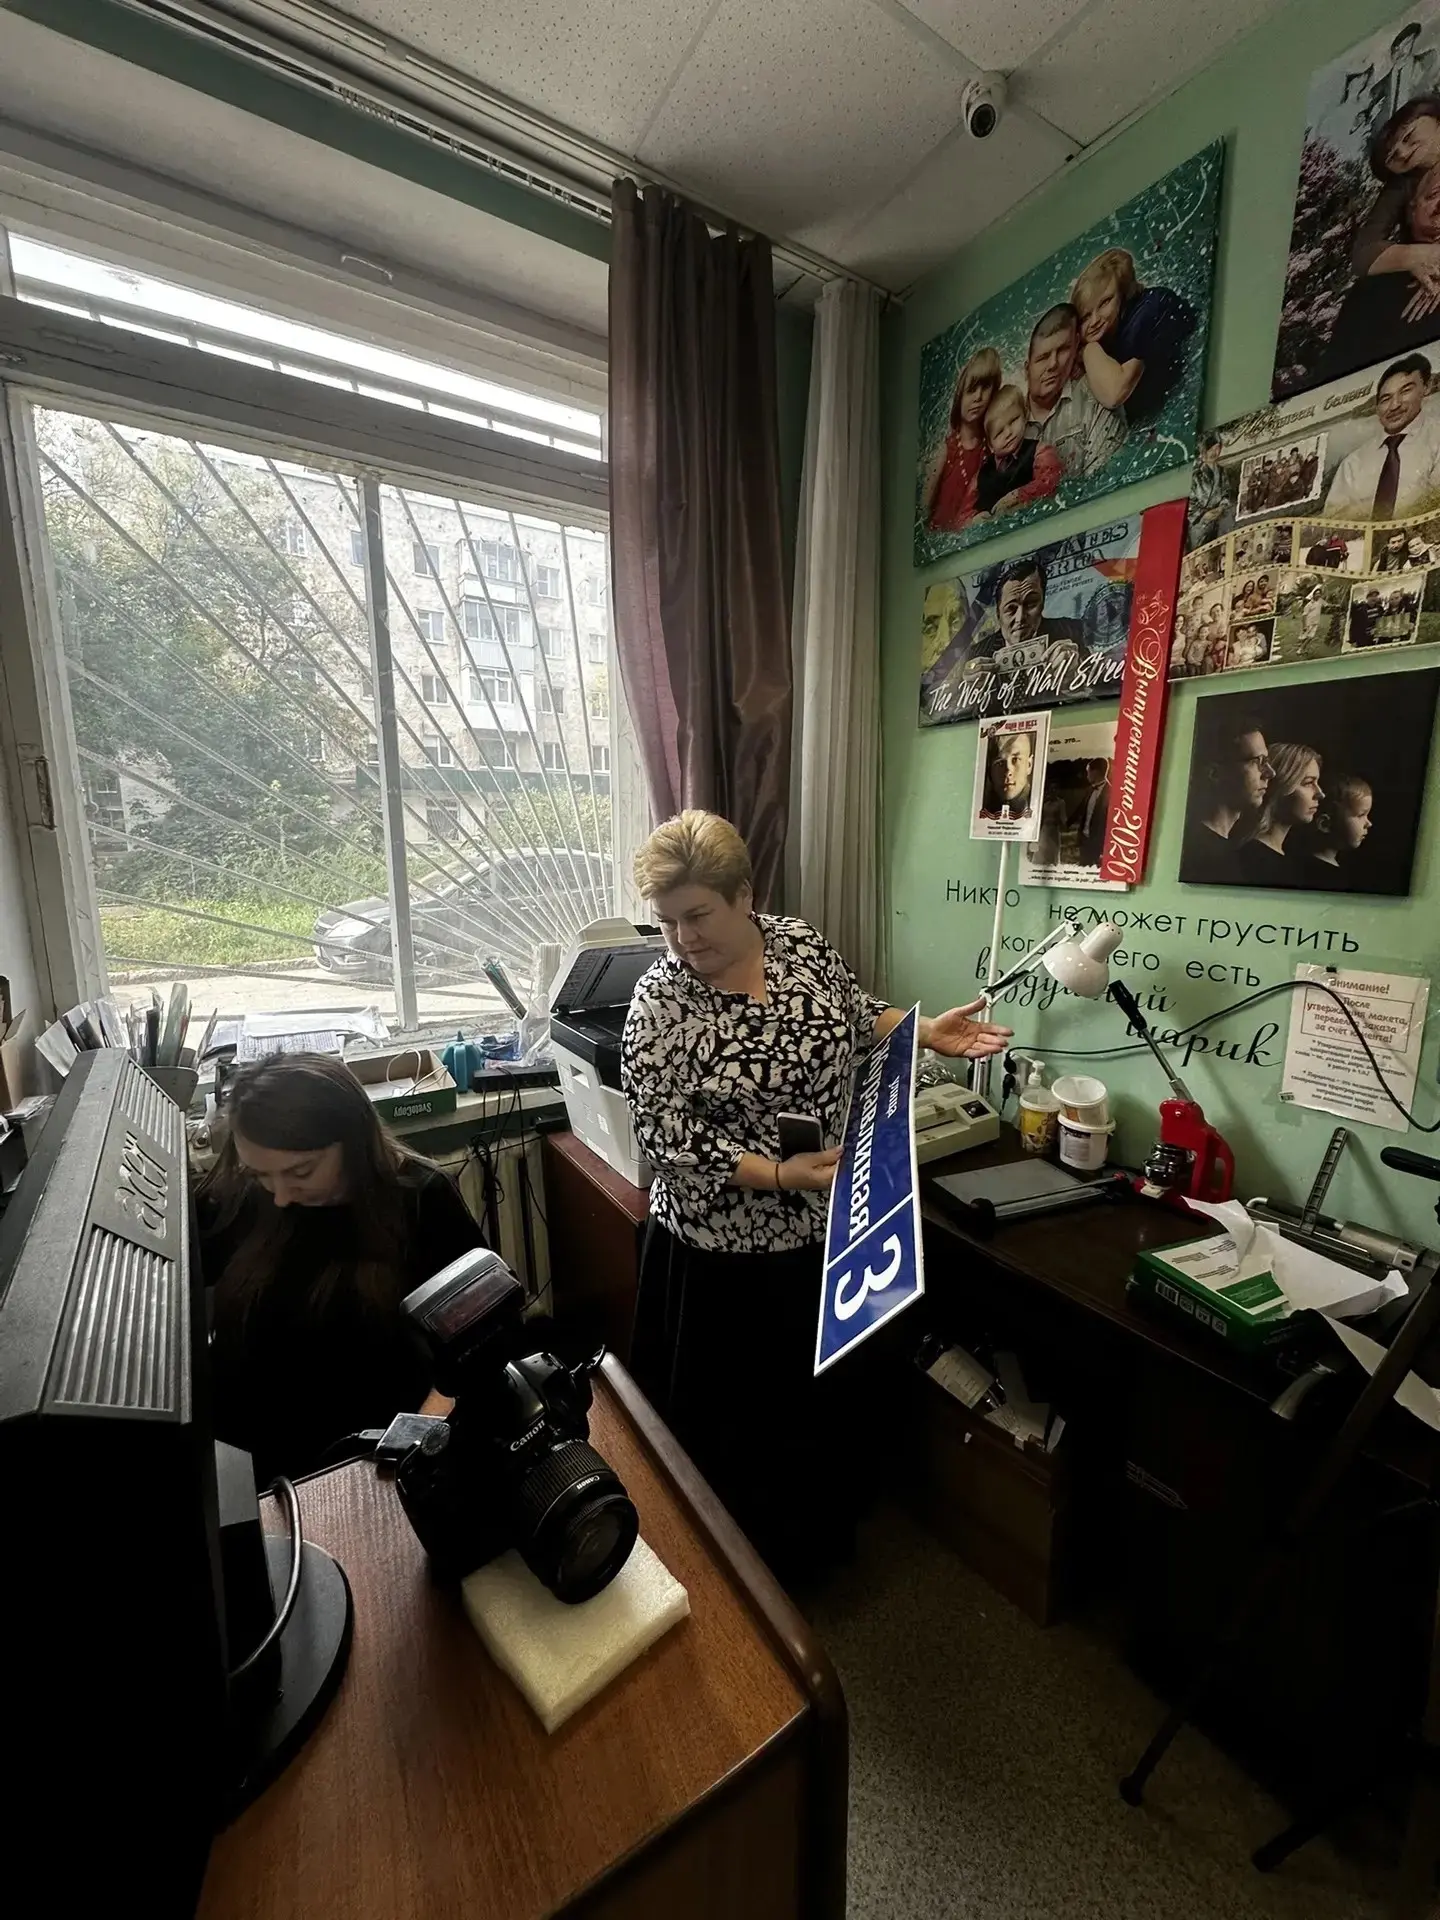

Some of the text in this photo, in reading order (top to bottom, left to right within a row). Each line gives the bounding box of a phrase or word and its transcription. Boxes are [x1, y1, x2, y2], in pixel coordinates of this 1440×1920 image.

[929, 683, 951, 715] The
[957, 671, 996, 712] Wolf
[997, 669, 1020, 709] of
[1025, 653, 1075, 696] Wall
[1107, 627, 1161, 883] Выпускница 2026
[946, 879, 1020, 908] Никто
[1049, 904, 1360, 953] не может грустить
[1106, 949, 1161, 971] его
[1186, 961, 1261, 988] есть
[1314, 1013, 1360, 1027] передела
[1343, 996, 1371, 1009] После
[393, 1101, 433, 1118] SvetoCopy
[887, 1076, 901, 1118] улица
[848, 1036, 890, 1241] Журавлиная
[833, 1232, 902, 1322] 3
[509, 1419, 546, 1452] Canon
[576, 1474, 600, 1490] Canon
